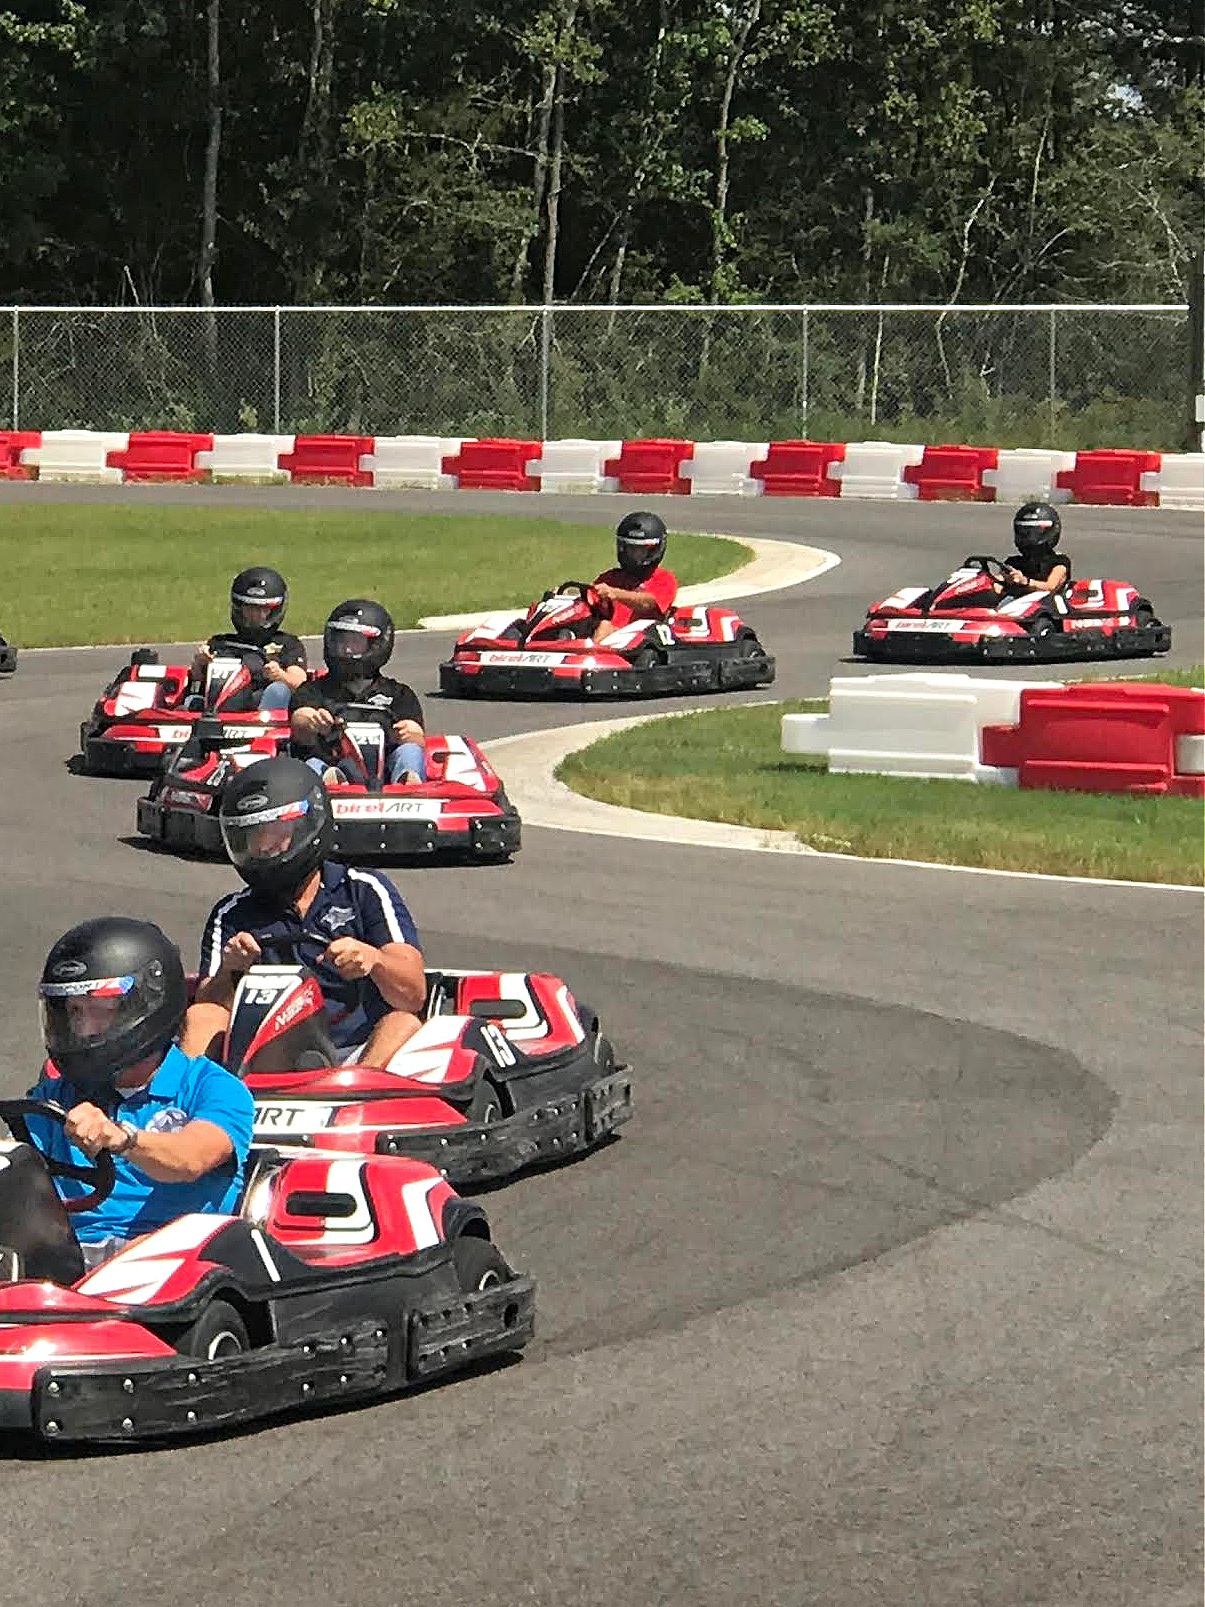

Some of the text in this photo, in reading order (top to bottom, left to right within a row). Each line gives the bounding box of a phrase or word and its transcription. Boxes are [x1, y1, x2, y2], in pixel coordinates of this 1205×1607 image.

[336, 800, 425, 815] birelART
[244, 988, 279, 1004] 13
[480, 1024, 517, 1068] 13
[250, 1228, 282, 1282] 1
